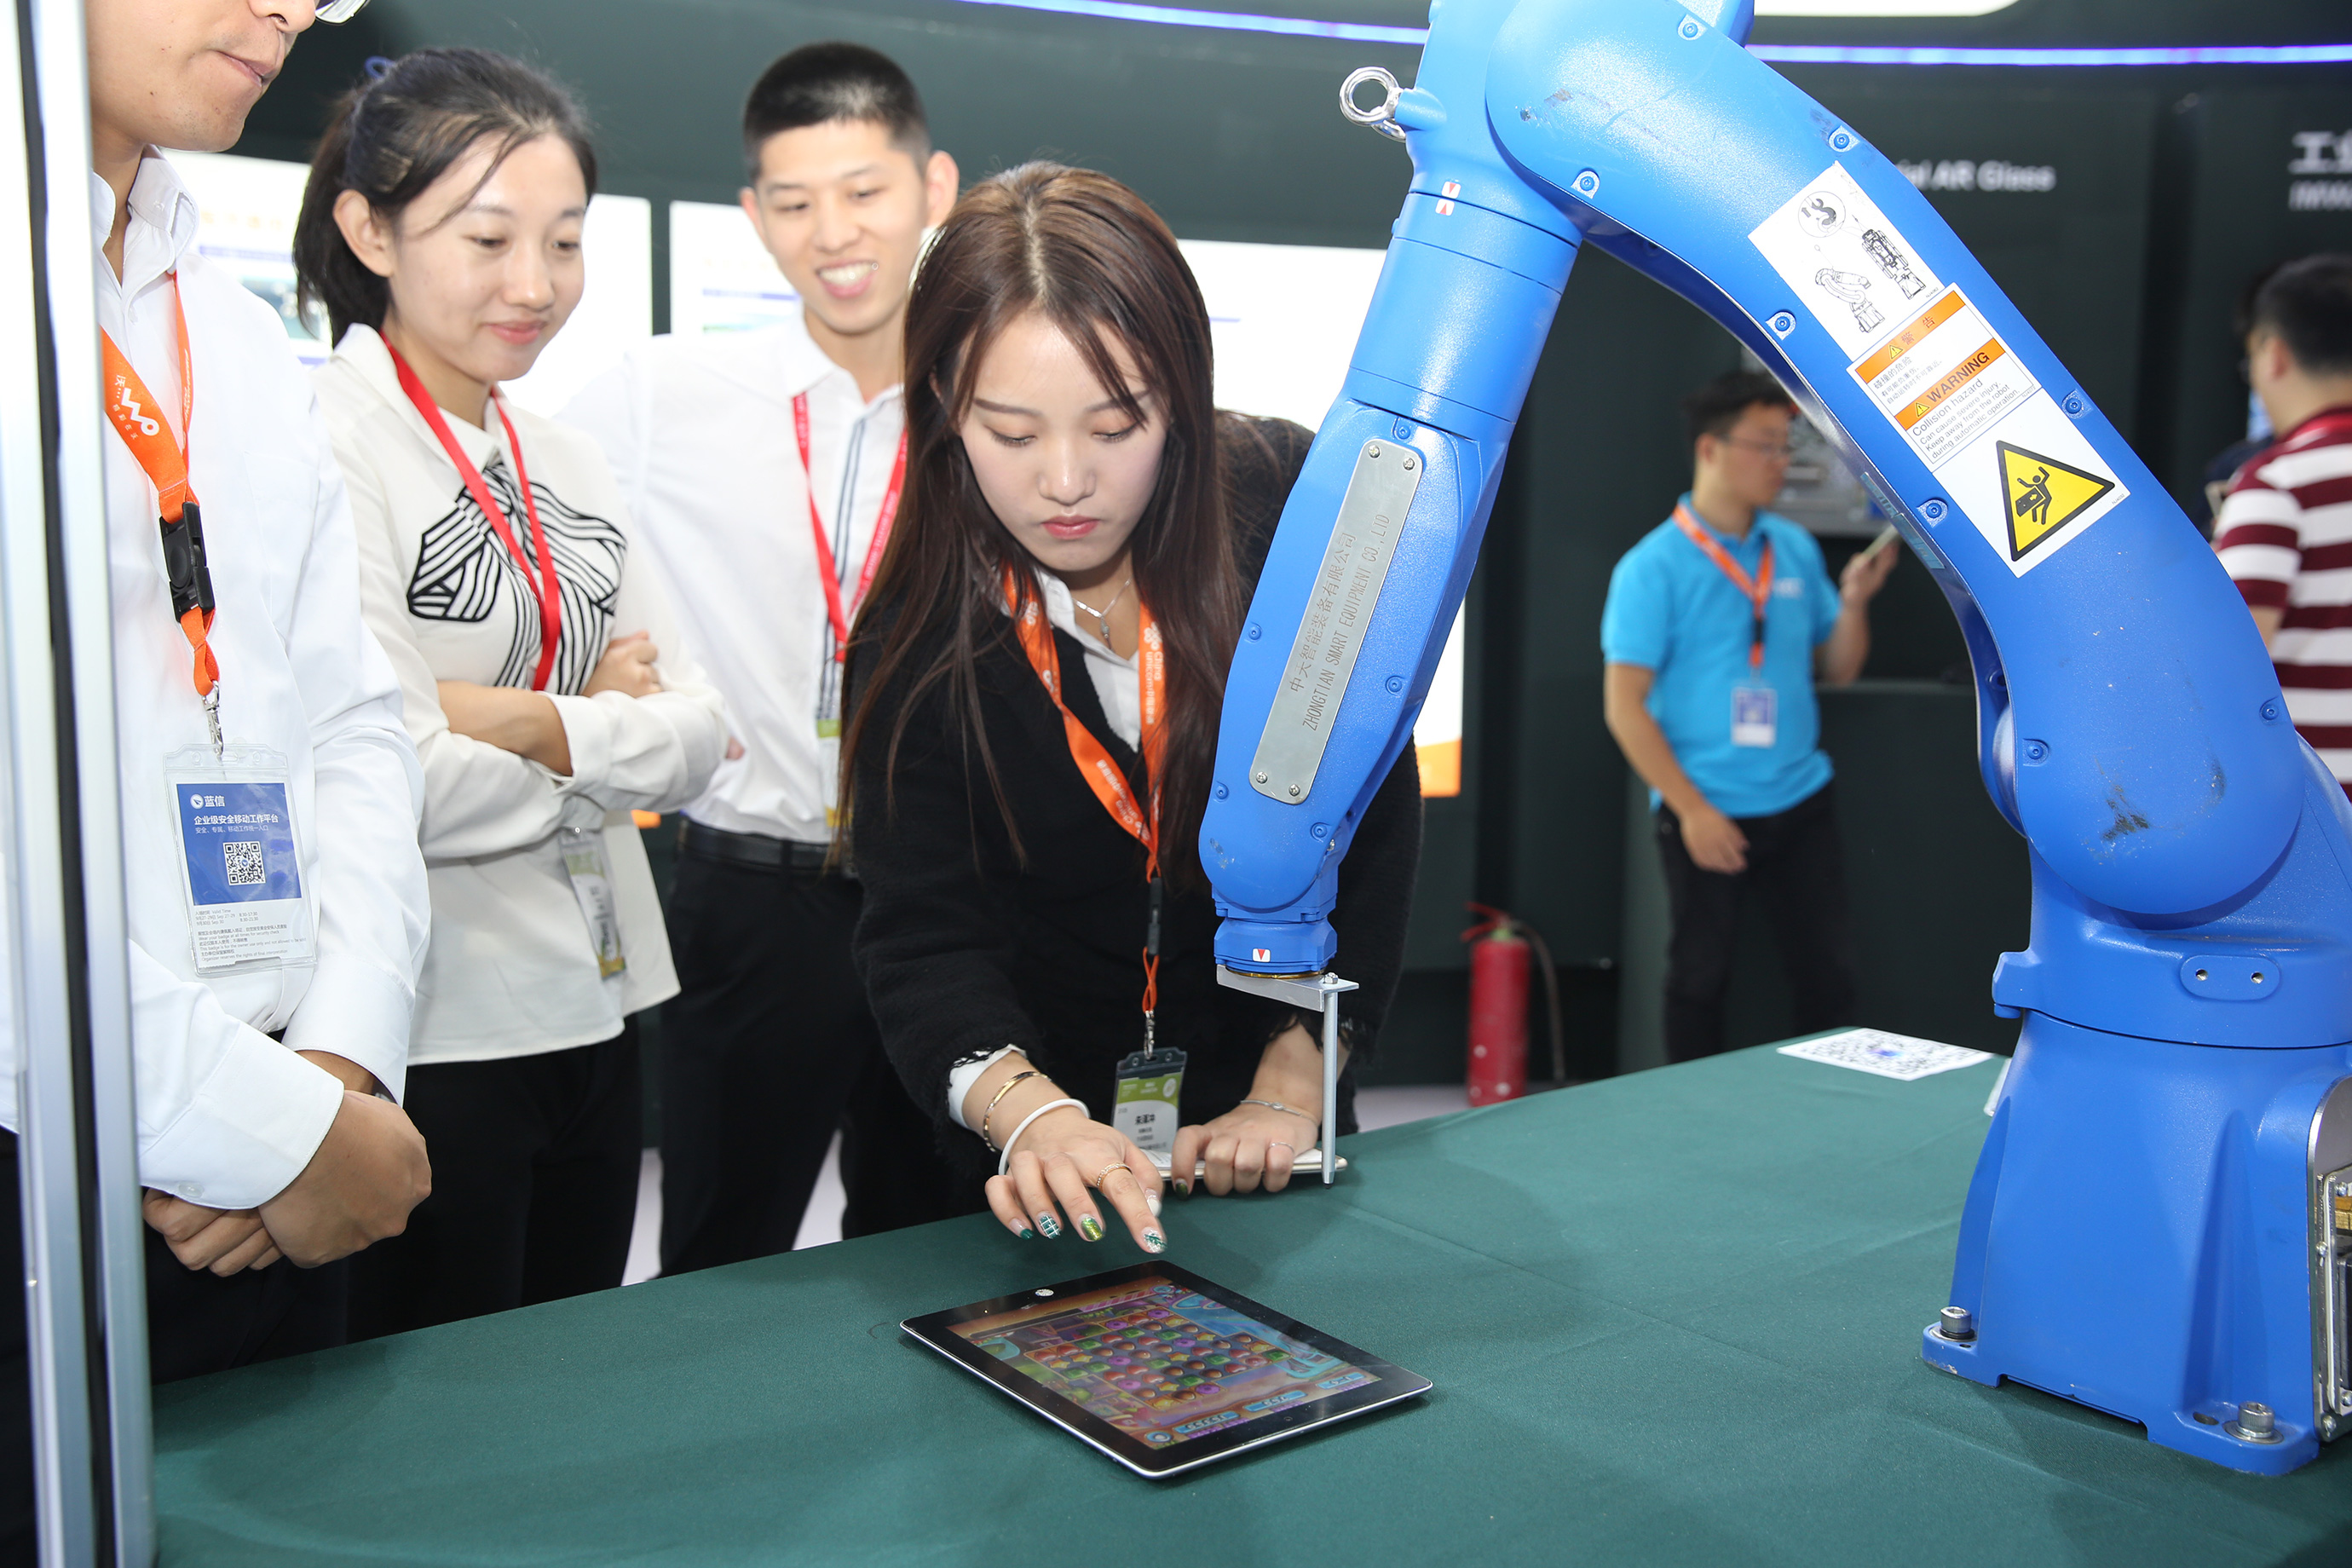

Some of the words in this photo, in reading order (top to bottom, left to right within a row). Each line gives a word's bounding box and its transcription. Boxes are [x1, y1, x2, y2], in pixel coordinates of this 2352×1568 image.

[1932, 160, 1975, 192] AR
[1977, 159, 2056, 192] Glass
[1926, 351, 1991, 402] WARNING
[1912, 405, 1951, 436] Collision
[1951, 378, 1983, 406] hazard
[1920, 431, 1935, 445] Can
[1935, 415, 1957, 433] cause
[1957, 397, 1980, 417] severe
[1980, 382, 2001, 400] injury.
[1926, 435, 1946, 452] Keep
[1946, 422, 1963, 437] away
[1963, 408, 1980, 423] from
[1980, 398, 1992, 410] the
[1992, 384, 2009, 402] robot
[1932, 439, 1955, 458] during
[1954, 415, 1987, 442] automatic
[1988, 389, 2020, 417] operation.
[1289, 532, 1357, 692] 中天智能装备有限公司
[1153, 651, 1163, 682] China
[1302, 668, 1336, 731] ZHONGTIAN
[1325, 630, 1348, 666] SMART
[1339, 565, 1371, 628] EQUIPMENT
[193, 814, 280, 826] 企业级安全移动工作平台
[204, 795, 226, 807] 蓝信
